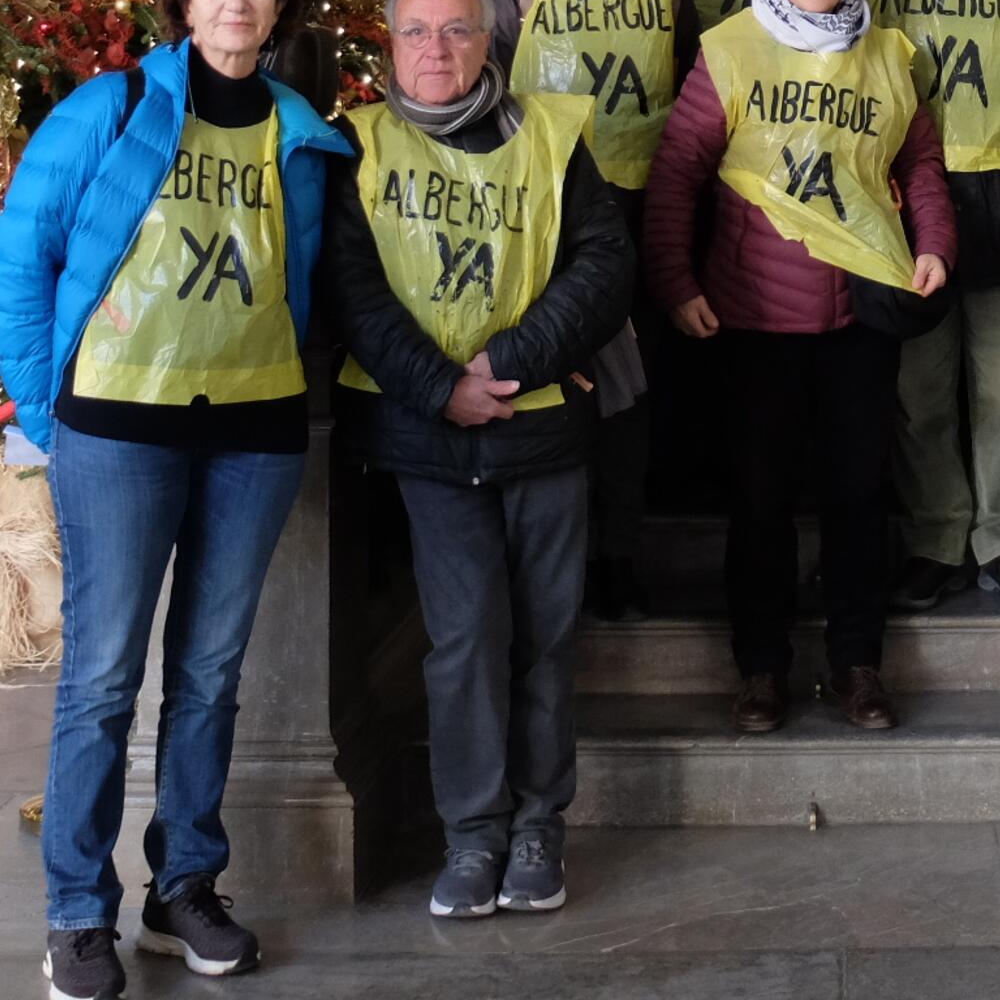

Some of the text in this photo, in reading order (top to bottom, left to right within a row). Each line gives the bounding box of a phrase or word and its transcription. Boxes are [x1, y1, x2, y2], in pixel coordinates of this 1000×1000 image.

[581, 51, 650, 117] YA
[925, 34, 989, 109] YA
[782, 146, 848, 223] YA
[176, 226, 253, 306] YA
[430, 231, 495, 313] YA
